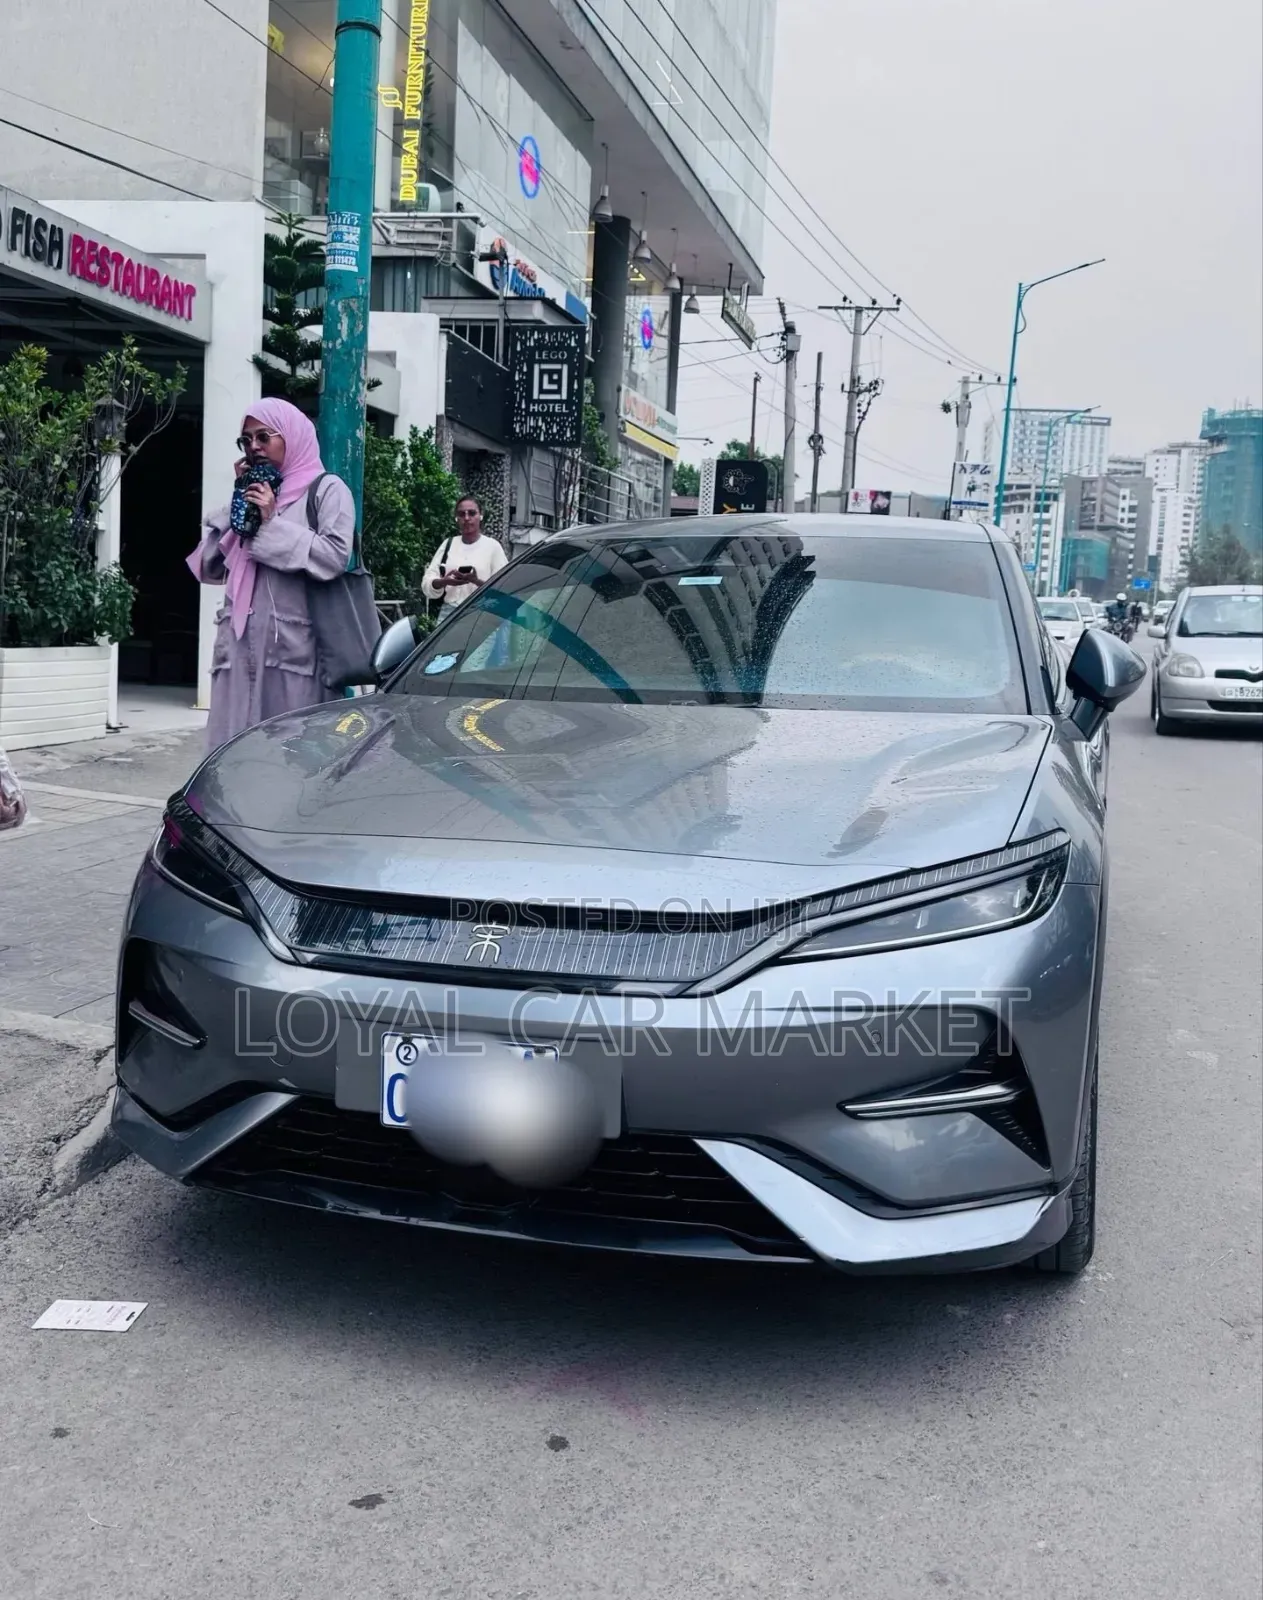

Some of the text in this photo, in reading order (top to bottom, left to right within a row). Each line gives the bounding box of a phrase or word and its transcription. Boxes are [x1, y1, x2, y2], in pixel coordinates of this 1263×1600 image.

[400, 130, 420, 201] DUBAI
[8, 206, 65, 270] FISH
[69, 232, 197, 321] RESTAURANT
[535, 350, 568, 360] LEGO
[529, 403, 570, 413] HOTEL
